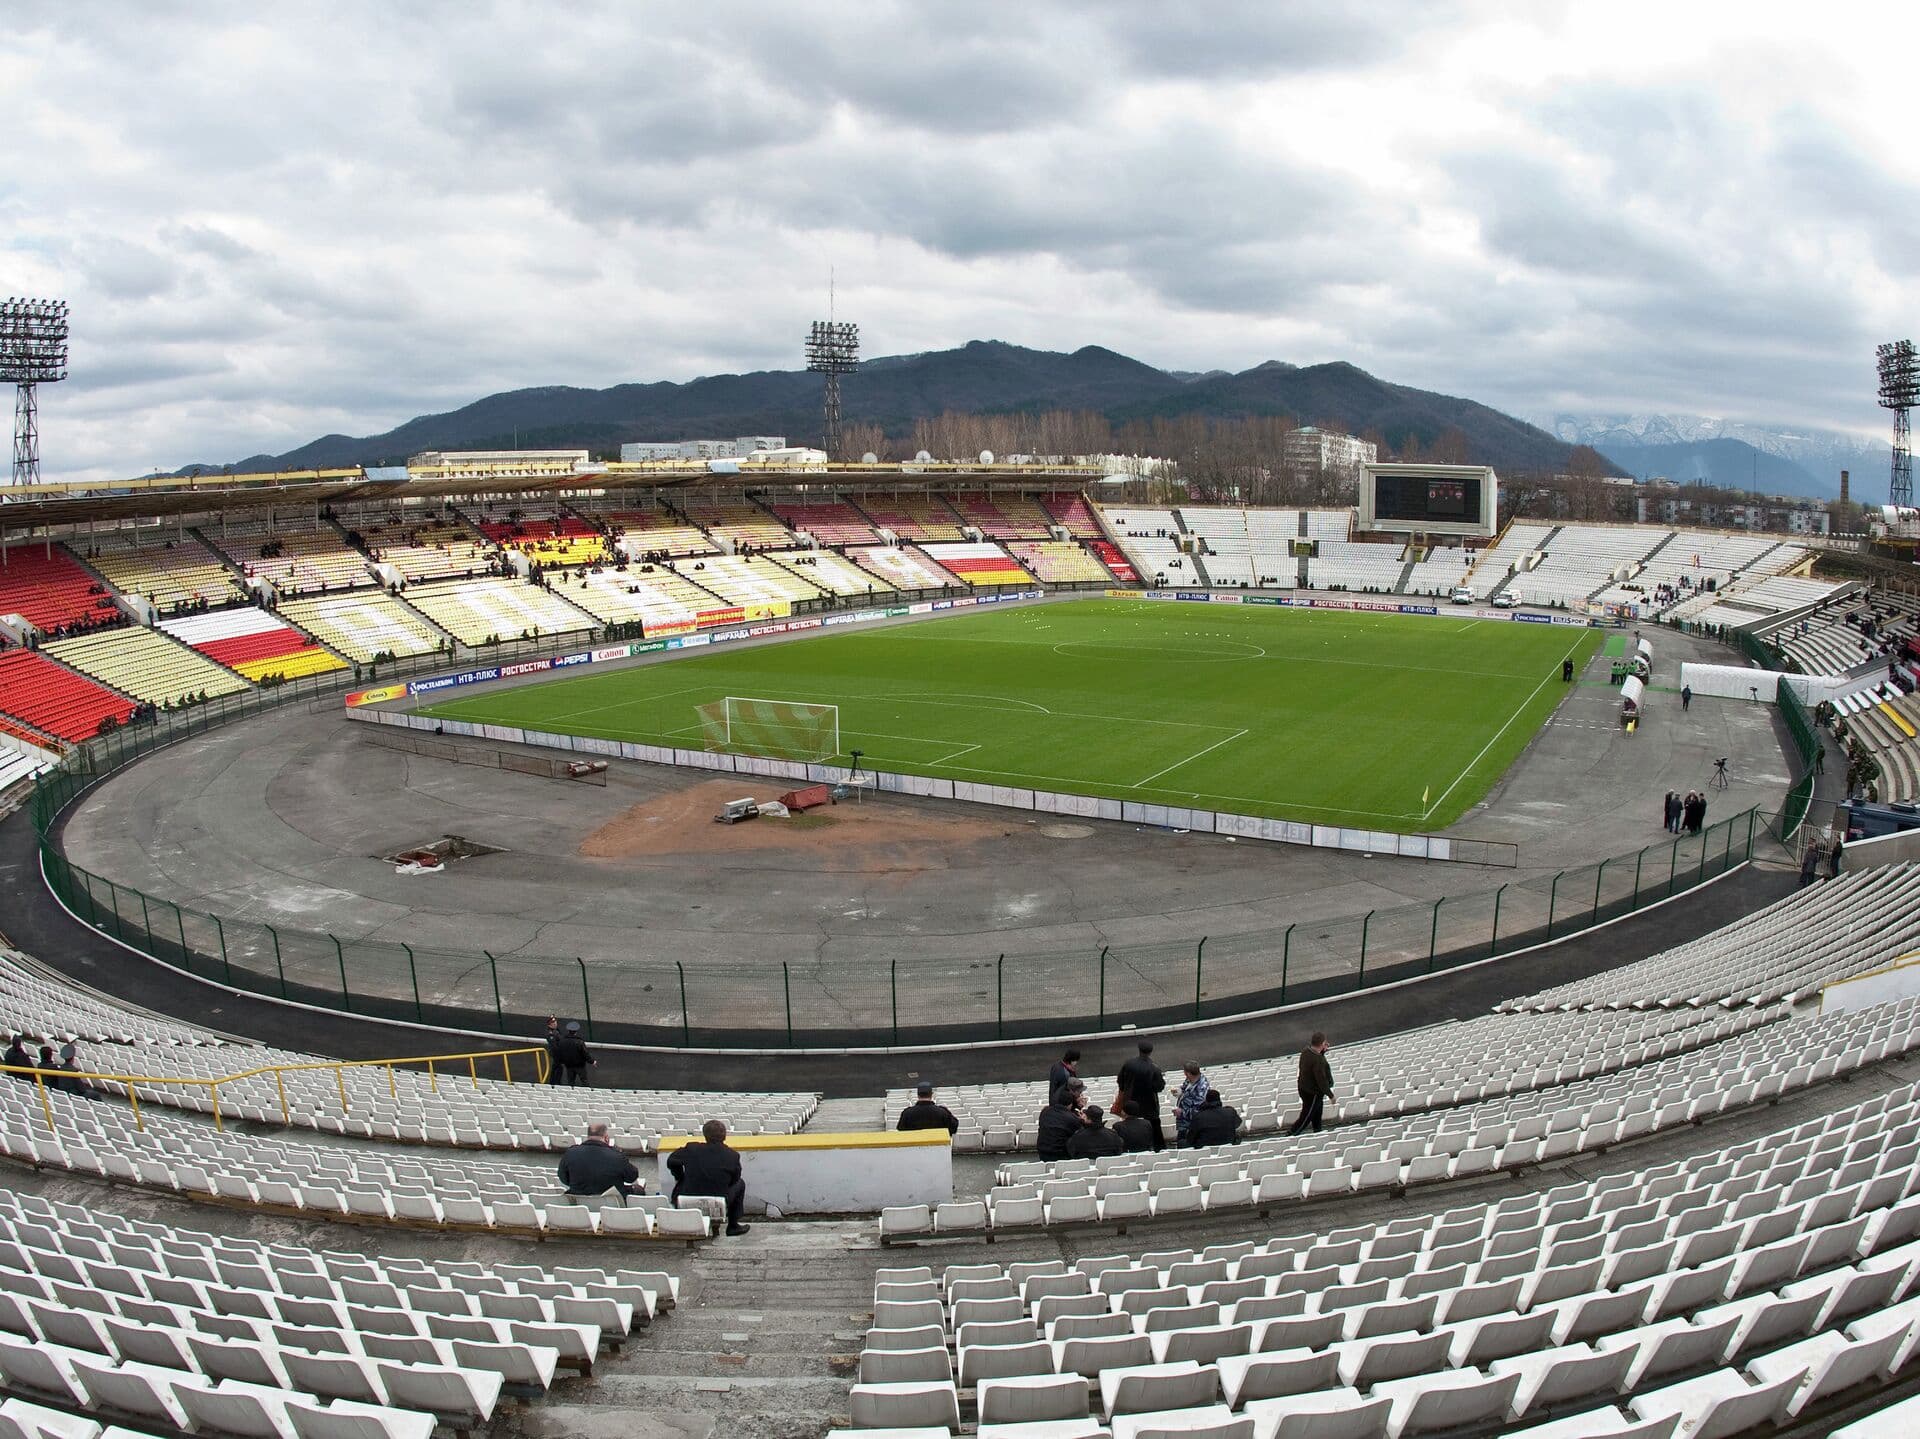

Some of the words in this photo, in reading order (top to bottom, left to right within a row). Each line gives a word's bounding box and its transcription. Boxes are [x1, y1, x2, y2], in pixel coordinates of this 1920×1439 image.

[563, 653, 588, 666] PEPSI
[598, 649, 624, 660] Canon
[501, 660, 550, 677] РОСГОССТРАХ
[458, 669, 497, 684] НТВ-ПЛЮС
